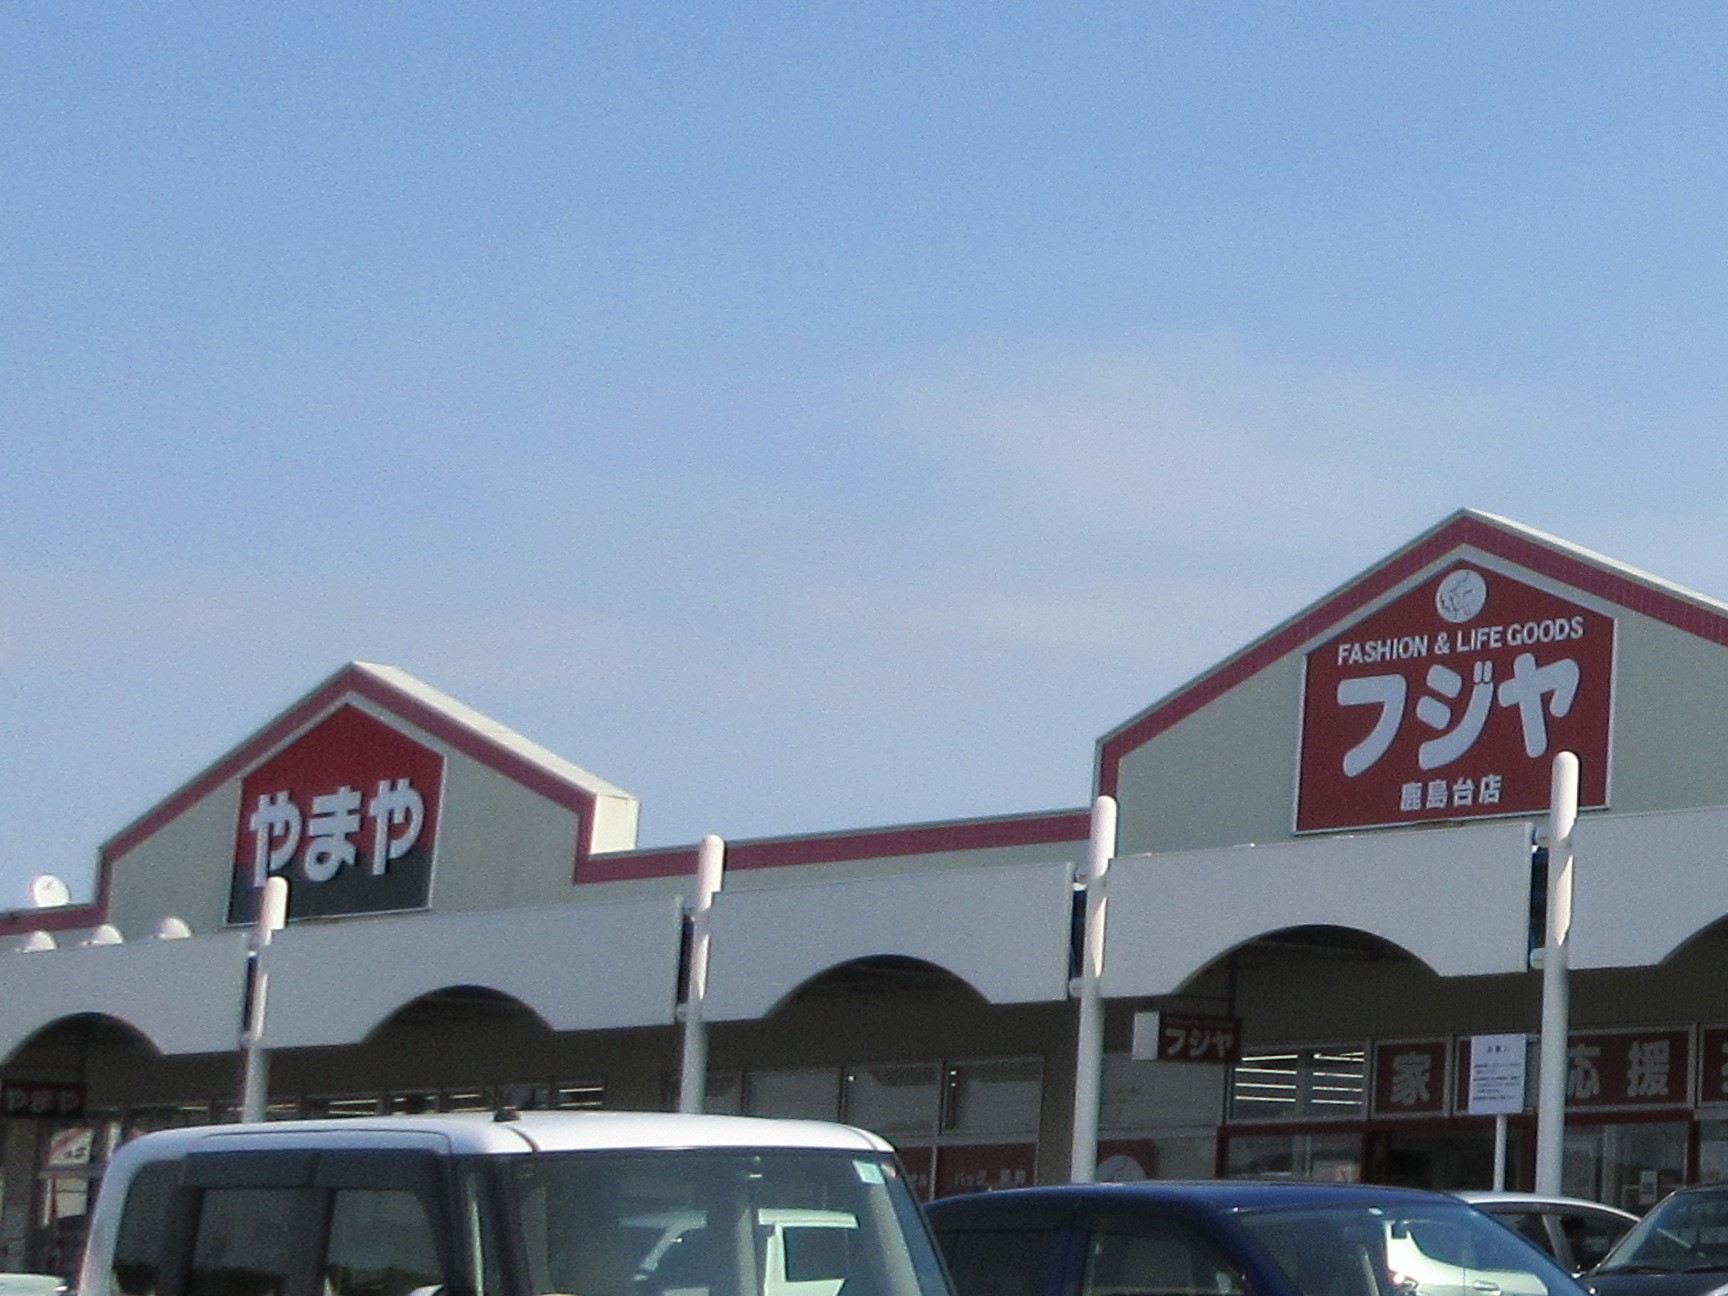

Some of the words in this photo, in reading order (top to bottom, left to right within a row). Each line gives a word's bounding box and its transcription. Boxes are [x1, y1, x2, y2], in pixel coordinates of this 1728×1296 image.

[1337, 633, 1429, 667] FASHION
[1434, 630, 1451, 656] &
[1456, 625, 1503, 654] LIFE
[1506, 615, 1585, 646] GOODS
[1336, 651, 1581, 778] フジヤ
[1401, 774, 1502, 811] 鹿島台店
[249, 777, 426, 888] やまや
[1164, 1028, 1235, 1059] フジヤ
